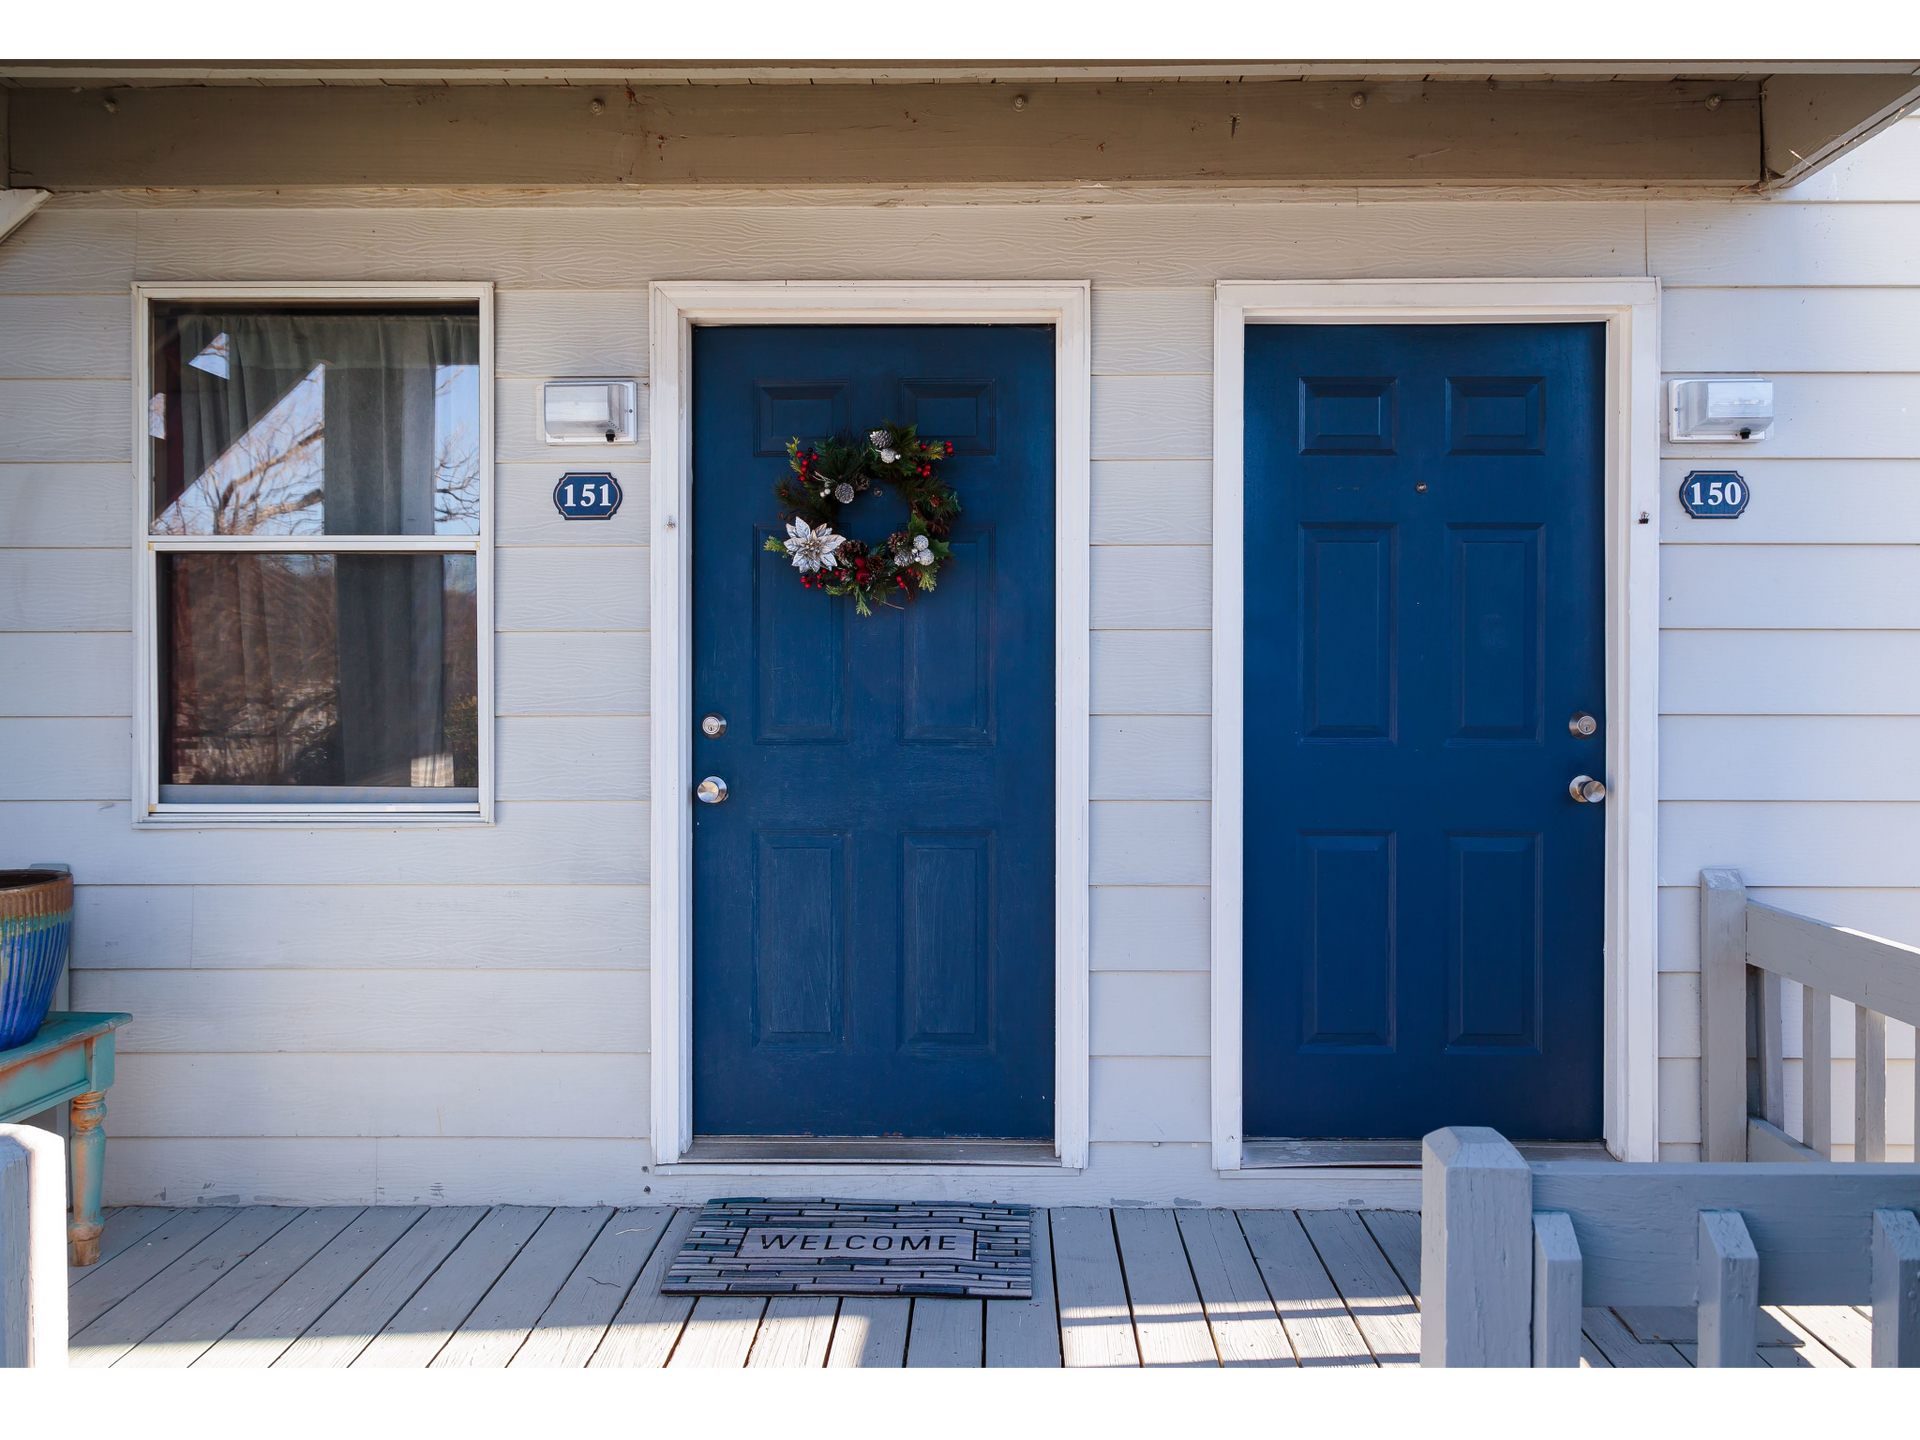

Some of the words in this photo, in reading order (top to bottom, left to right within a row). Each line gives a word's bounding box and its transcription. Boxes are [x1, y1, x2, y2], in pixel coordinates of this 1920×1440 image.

[564, 483, 611, 507] 151
[1691, 481, 1742, 506] 150
[761, 1234, 957, 1251] WELCOME
